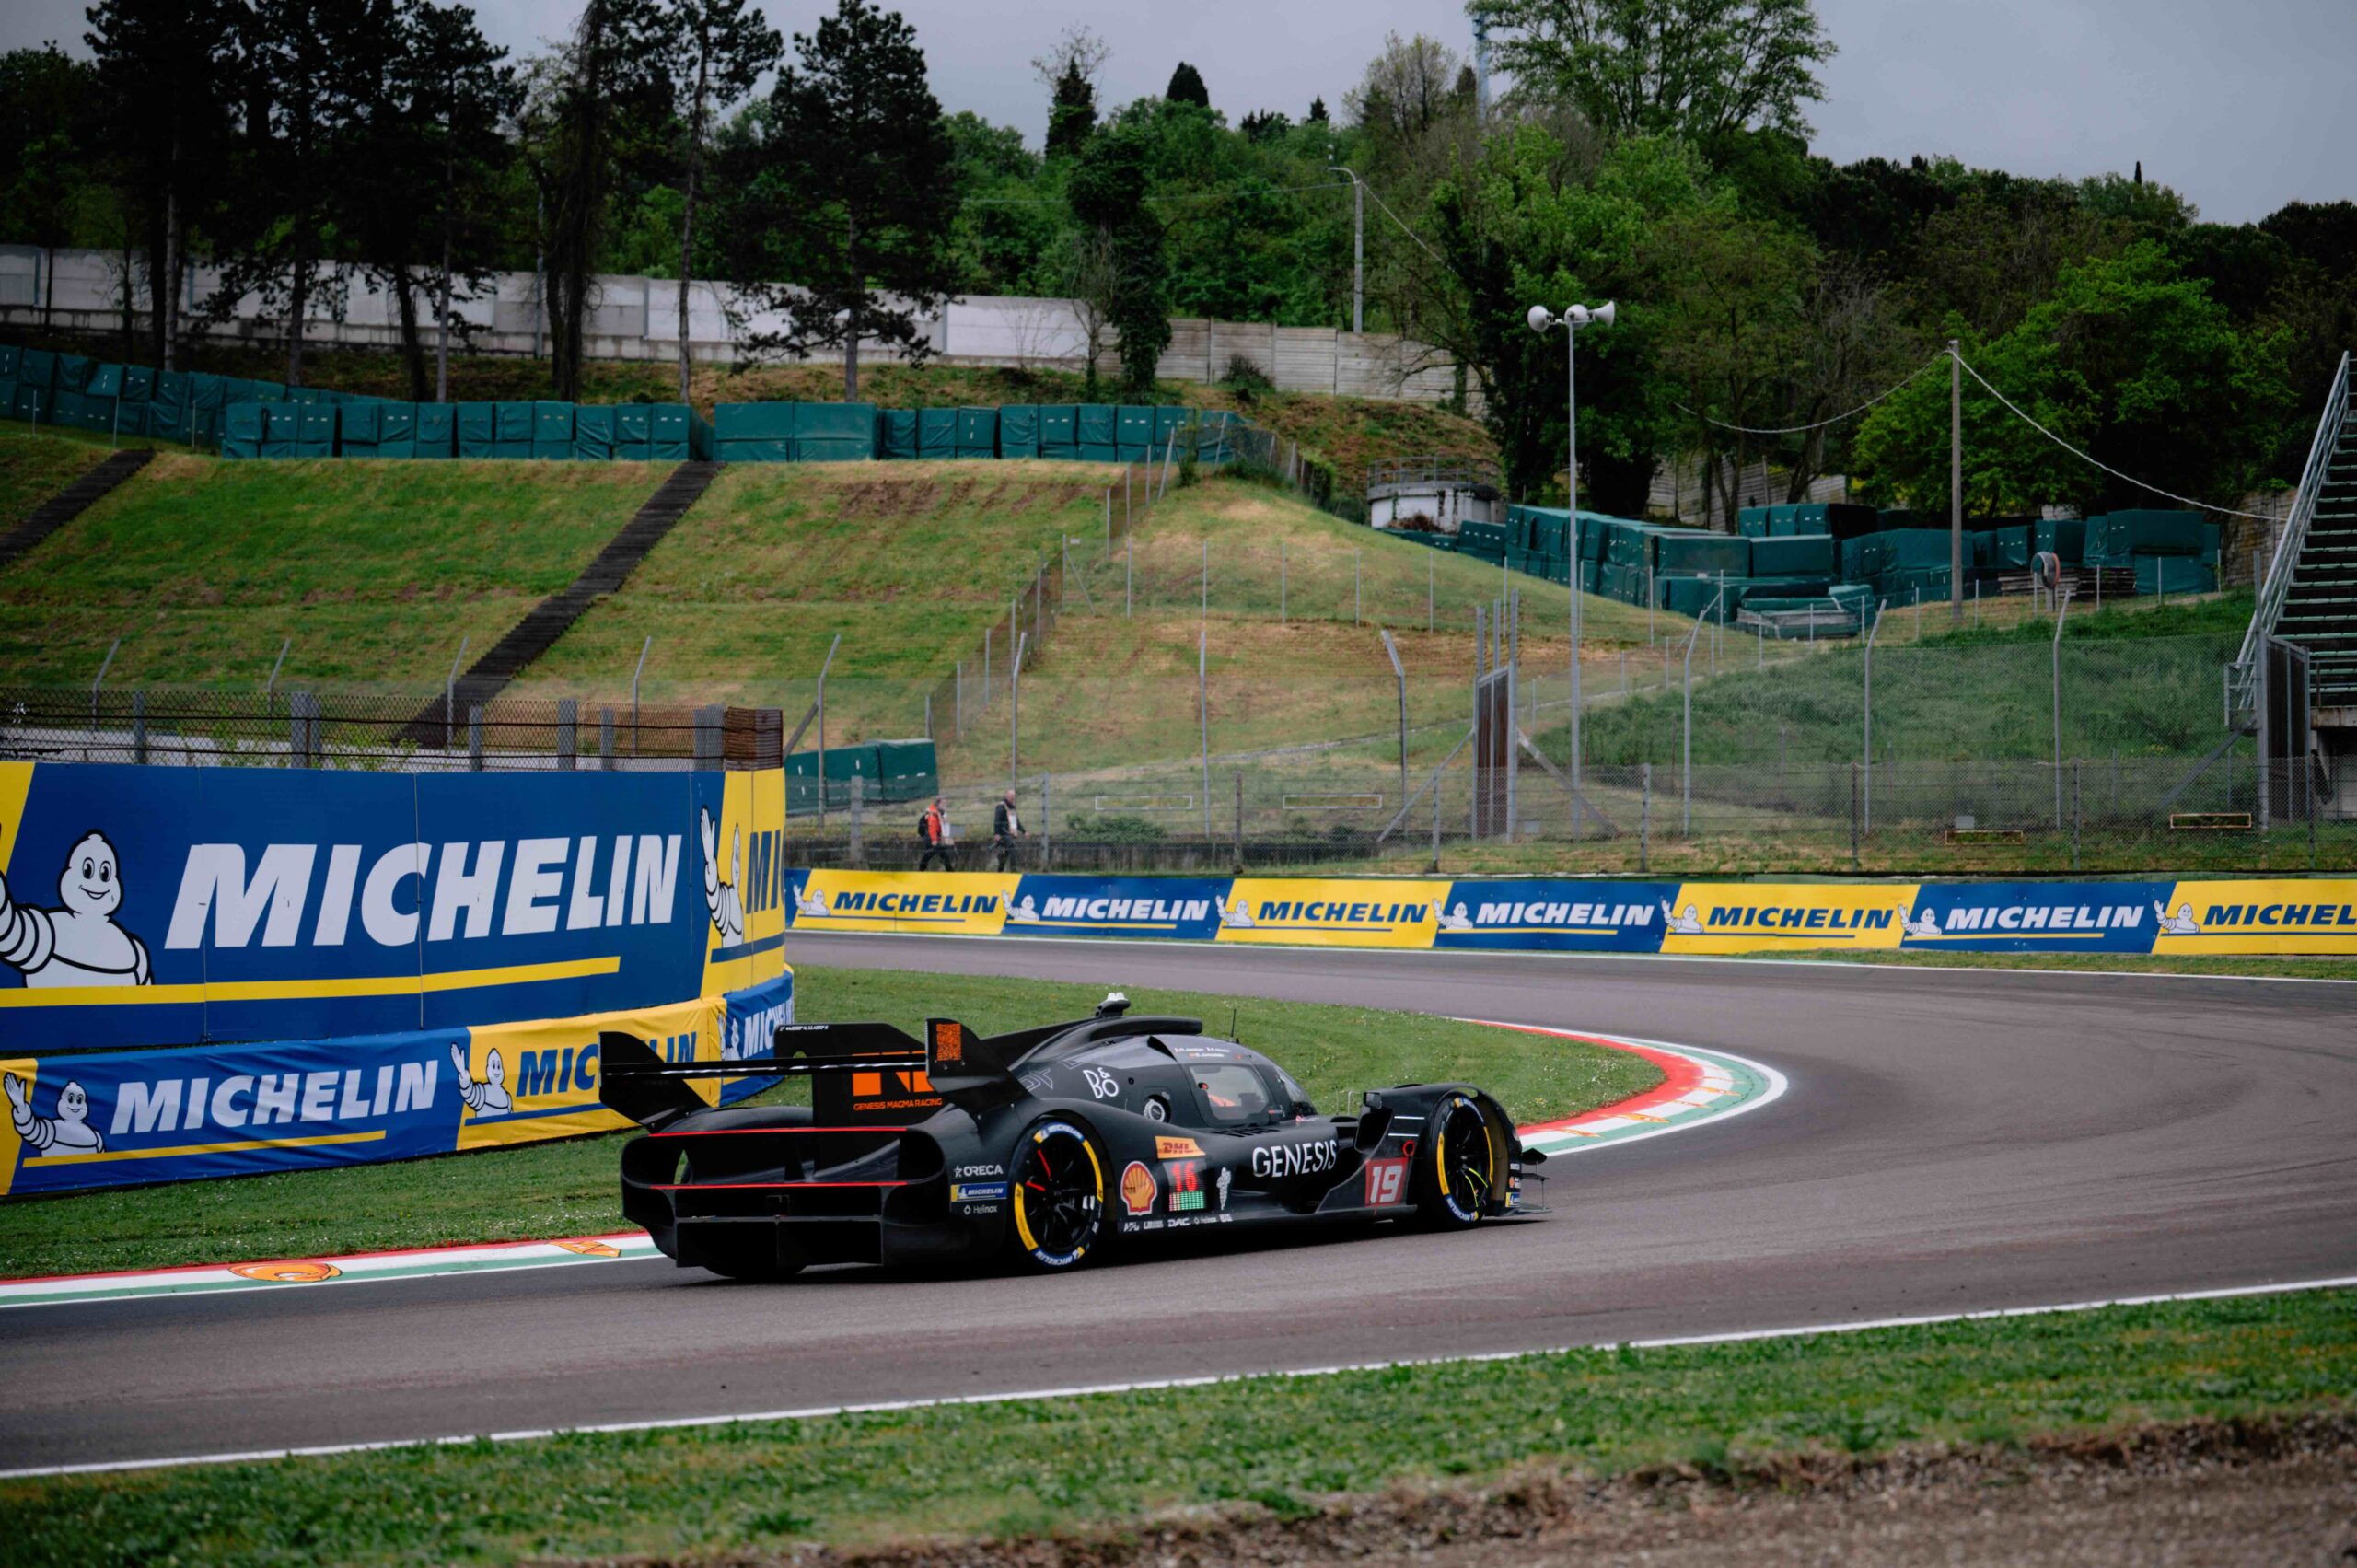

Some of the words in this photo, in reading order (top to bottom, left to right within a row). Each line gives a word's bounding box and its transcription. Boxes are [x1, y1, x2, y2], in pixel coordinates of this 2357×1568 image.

[164, 834, 682, 949] MICHELIN
[835, 892, 998, 913] MICHELIN
[1042, 898, 1210, 920] MICHELIN
[1258, 902, 1428, 923] MICHELIN
[1475, 902, 1655, 926] MICHELIN
[1708, 907, 1894, 929] MICHELIN
[1945, 906, 2144, 930] MICHELIN
[110, 1060, 438, 1135] MICHELIN
[853, 1101, 885, 1110] GENESIS
[887, 1099, 914, 1109] MAGMA
[914, 1098, 943, 1107] RACING
[1162, 1142, 1194, 1154] DHL
[1252, 1139, 1338, 1178] GENESIS
[963, 1164, 1004, 1177] ORECA
[1170, 1160, 1198, 1193] 16
[968, 1187, 1004, 1195] MICHELIN
[1370, 1165, 1403, 1203] 19
